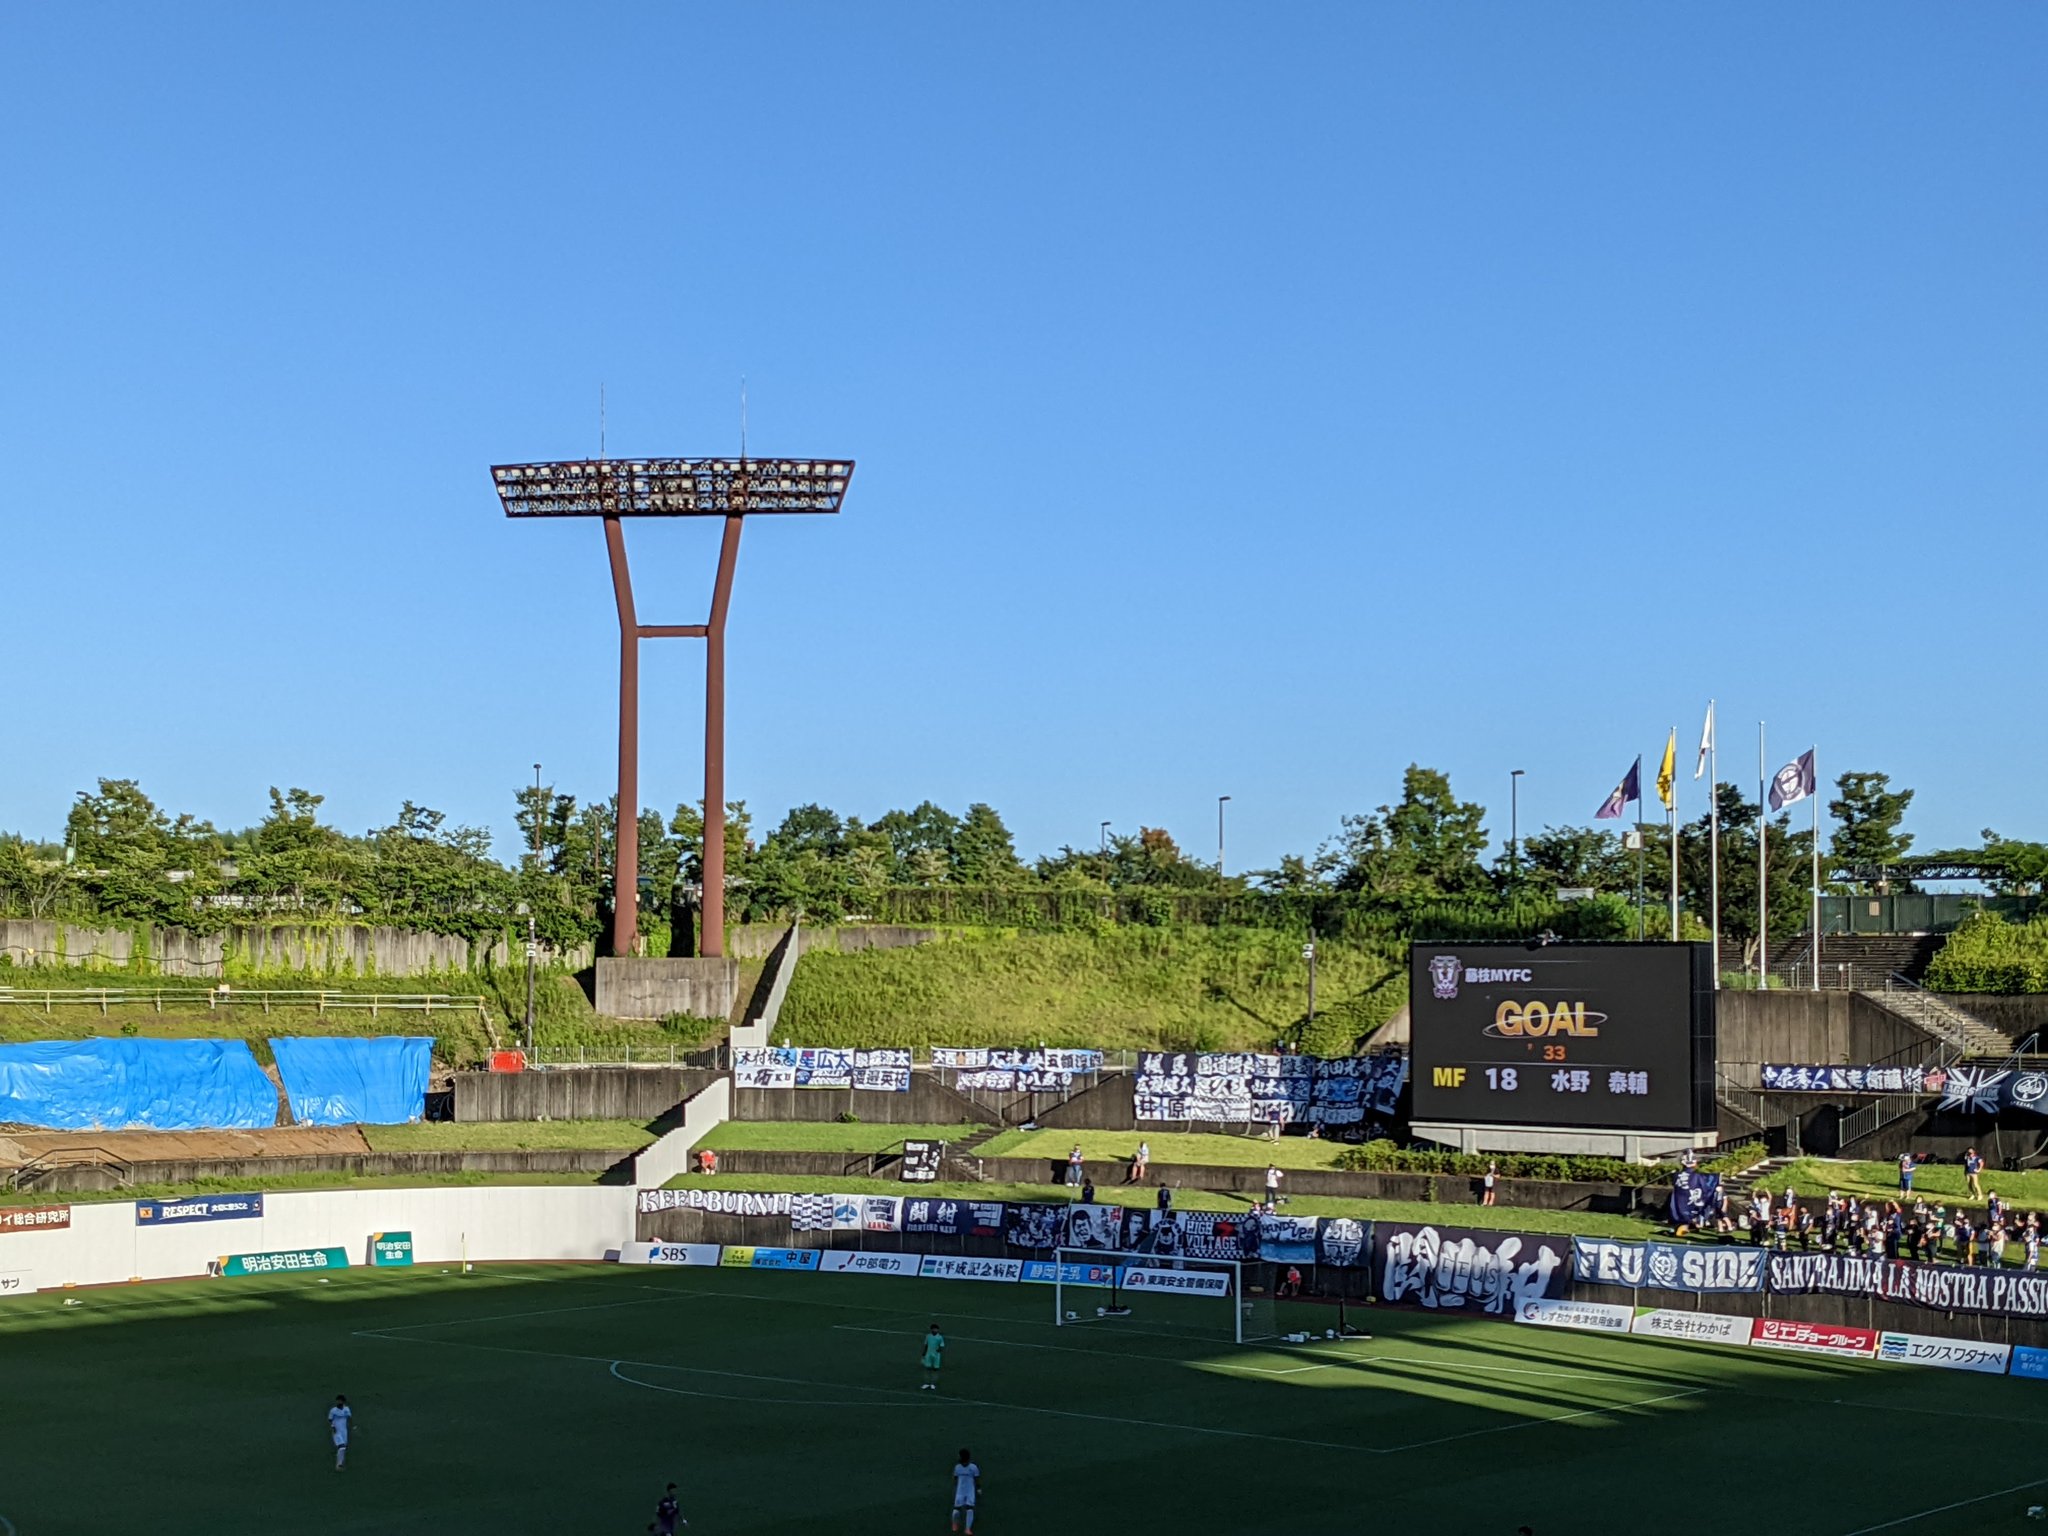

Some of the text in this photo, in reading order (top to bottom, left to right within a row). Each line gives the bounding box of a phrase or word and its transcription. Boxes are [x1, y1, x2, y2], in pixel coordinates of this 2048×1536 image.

[1496, 1000, 1598, 1037] GOAL
[1432, 1067, 1648, 1095] MF 18 水野 泰輔
[162, 1203, 209, 1218] RESPECT
[640, 1189, 704, 1213] KEEP
[705, 1190, 769, 1216] BURN
[772, 1193, 794, 1215] IT
[1186, 1220, 1213, 1236] HIGH
[1261, 1219, 1297, 1233] HANDS
[376, 1241, 411, 1250] 明治安田
[1186, 1235, 1237, 1251] VOLTAGE
[241, 1251, 328, 1271] 明治安田生命
[385, 1250, 403, 1260] 生命
[661, 1247, 688, 1262] SBS
[785, 1251, 811, 1265] 中屋
[855, 1257, 901, 1271] 中部電力
[943, 1260, 1019, 1279] 平成記念病院
[1577, 1242, 1761, 1288] FEU SIDE
[1915, 1268, 1989, 1310] NOSTRA
[1991, 1275, 2048, 1315] PASSI
[1541, 1311, 1624, 1328] しずおか焼津信用金庫
[1651, 1317, 1732, 1336] 株式会社わかば
[1778, 1327, 1867, 1348] エンチョーグループ
